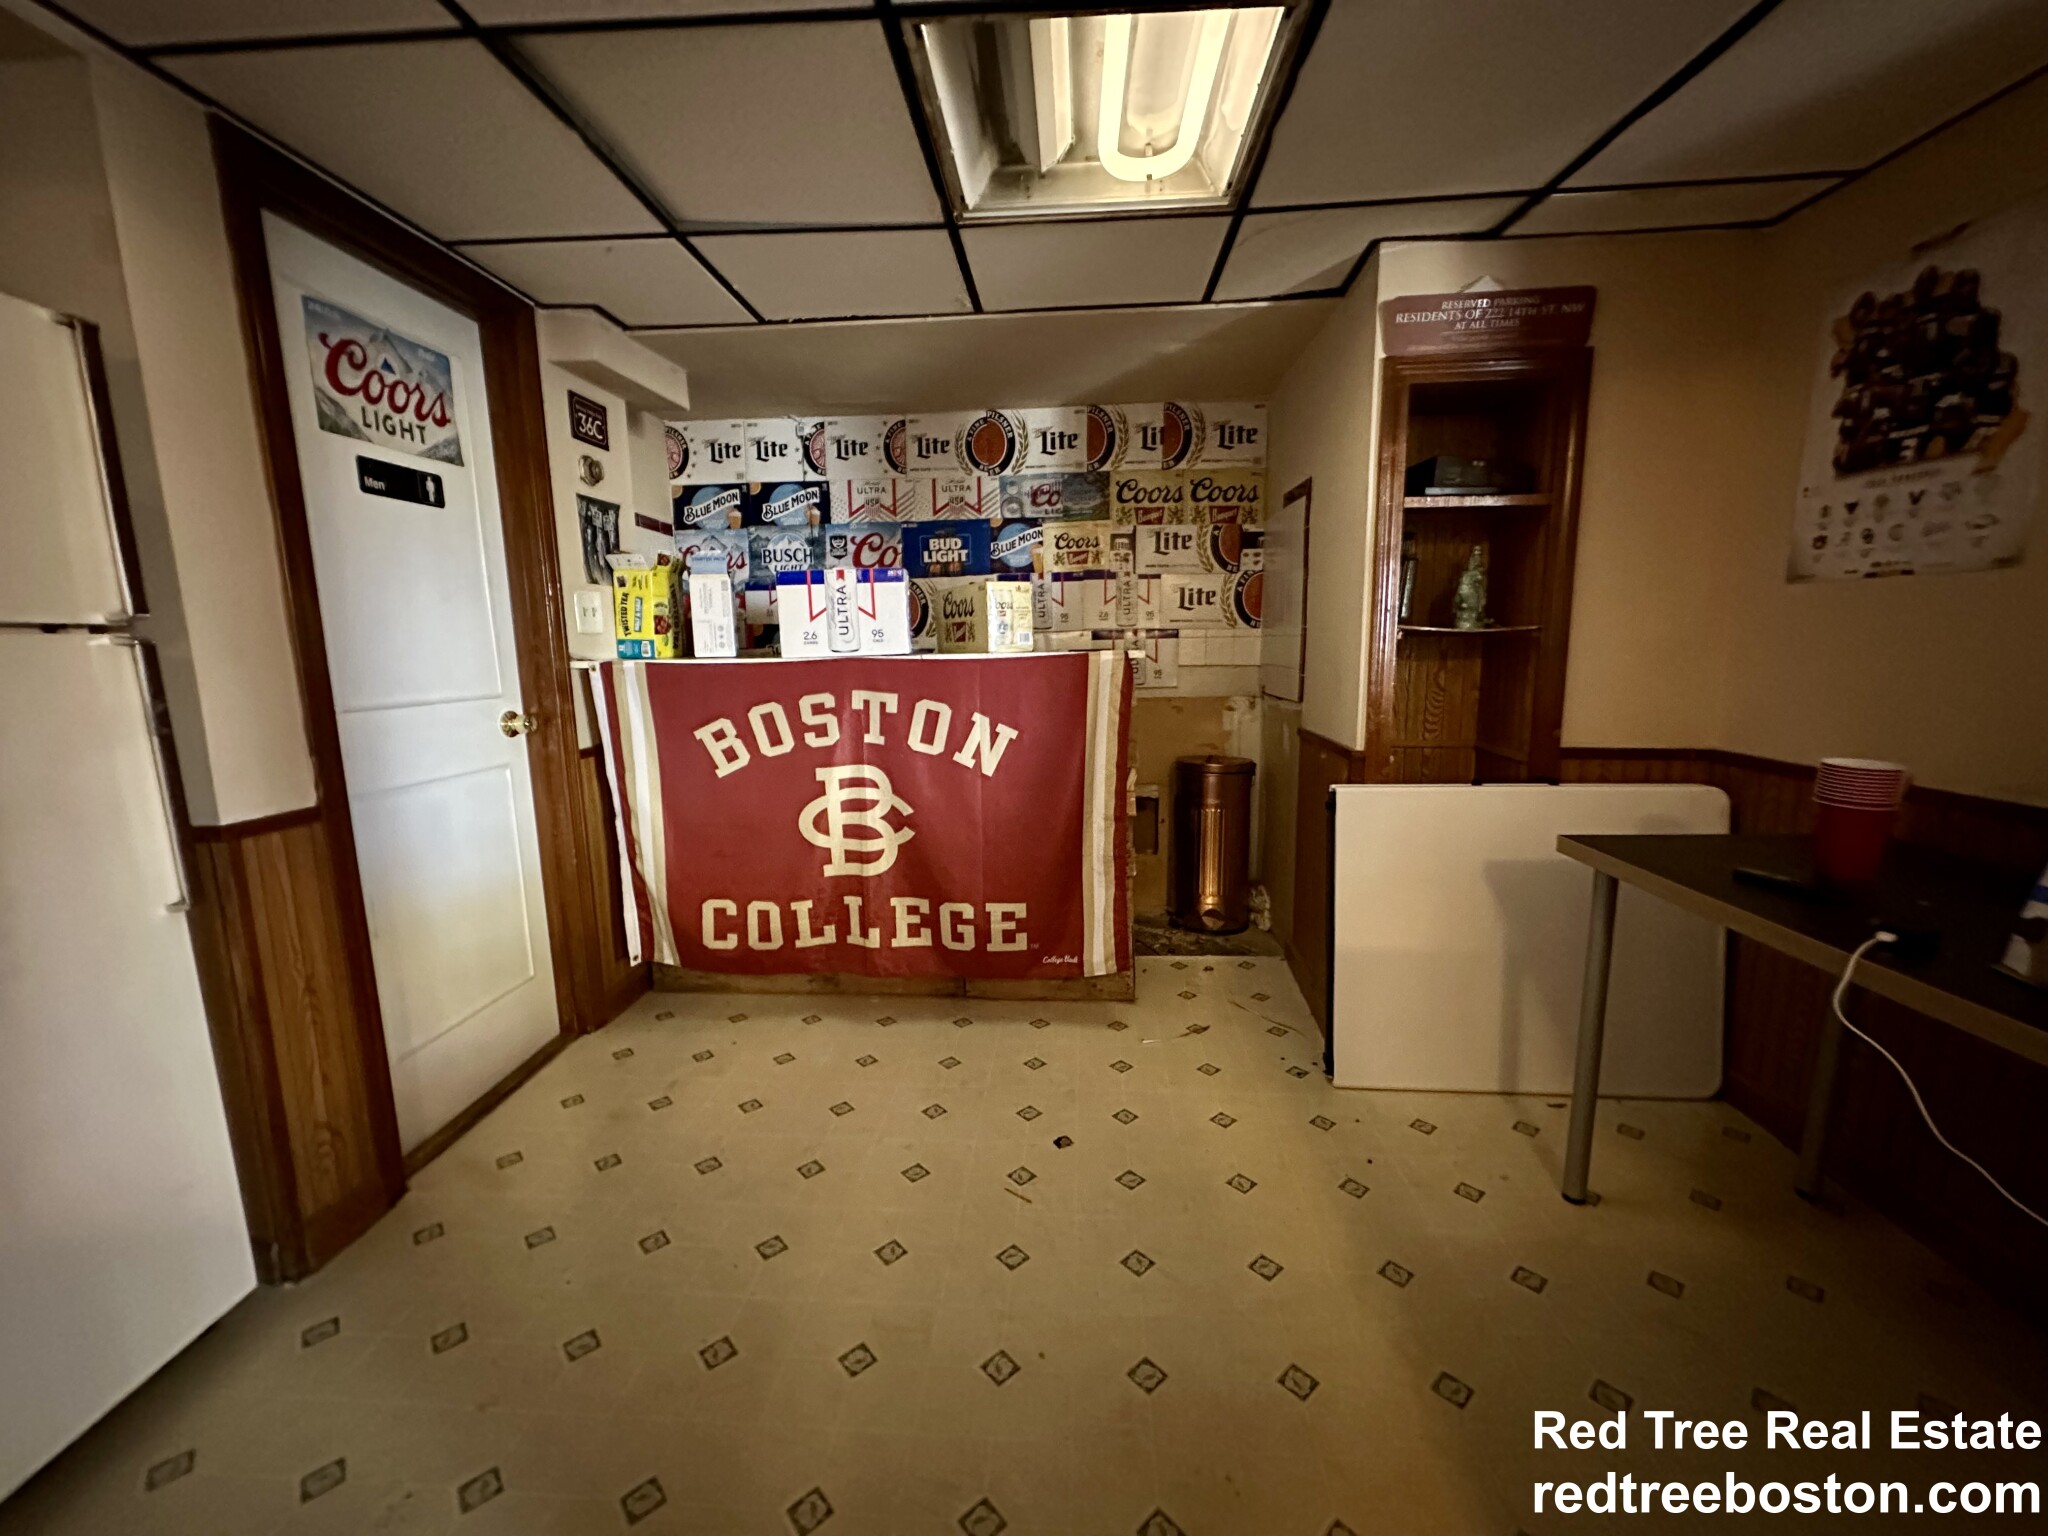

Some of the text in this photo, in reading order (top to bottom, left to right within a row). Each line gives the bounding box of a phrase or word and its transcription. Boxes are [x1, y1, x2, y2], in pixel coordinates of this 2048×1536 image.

[1441, 295, 1541, 310] RESERVED PARKING
[1395, 310, 1461, 324] RESIDENTS
[1465, 309, 1484, 320] OF
[1454, 318, 1521, 330] AT ALL TIMES
[318, 332, 452, 428] Coors
[360, 405, 427, 446] LIGHT
[986, 410, 1014, 439] PILSNER
[1217, 422, 1258, 451] Lite
[755, 440, 788, 462] Lite
[835, 438, 869, 461] Lite
[916, 436, 950, 459] Lite
[1040, 430, 1079, 456] Lite
[1141, 425, 1164, 451] Lit
[709, 441, 742, 464] Lite
[363, 475, 386, 491] Men
[856, 486, 887, 495] ULTRA
[941, 484, 972, 494] ULTRA
[1116, 478, 1184, 504] Coors
[1190, 477, 1260, 503] Coors
[684, 492, 739, 523] BLUE MOON
[762, 489, 818, 521] BLUE MOON
[928, 537, 962, 551] BUD
[990, 528, 1043, 557] BLUE MOON
[1054, 532, 1100, 550] Coors
[1152, 530, 1193, 556] Lite
[762, 549, 813, 564] BUSCH
[774, 563, 803, 571] LIGHT
[923, 550, 969, 563] LIGHT
[836, 584, 850, 636] ULTRA
[942, 591, 975, 620] Coors
[1038, 583, 1046, 618] ULTRA
[1123, 580, 1131, 615] ULTRA
[1177, 587, 1217, 611] Lite
[620, 592, 631, 637] TWISTED TEA
[803, 631, 818, 641] 2.6
[871, 629, 884, 638] 95
[693, 688, 1020, 779] BOSTON
[701, 895, 1028, 952] COLLEGE
